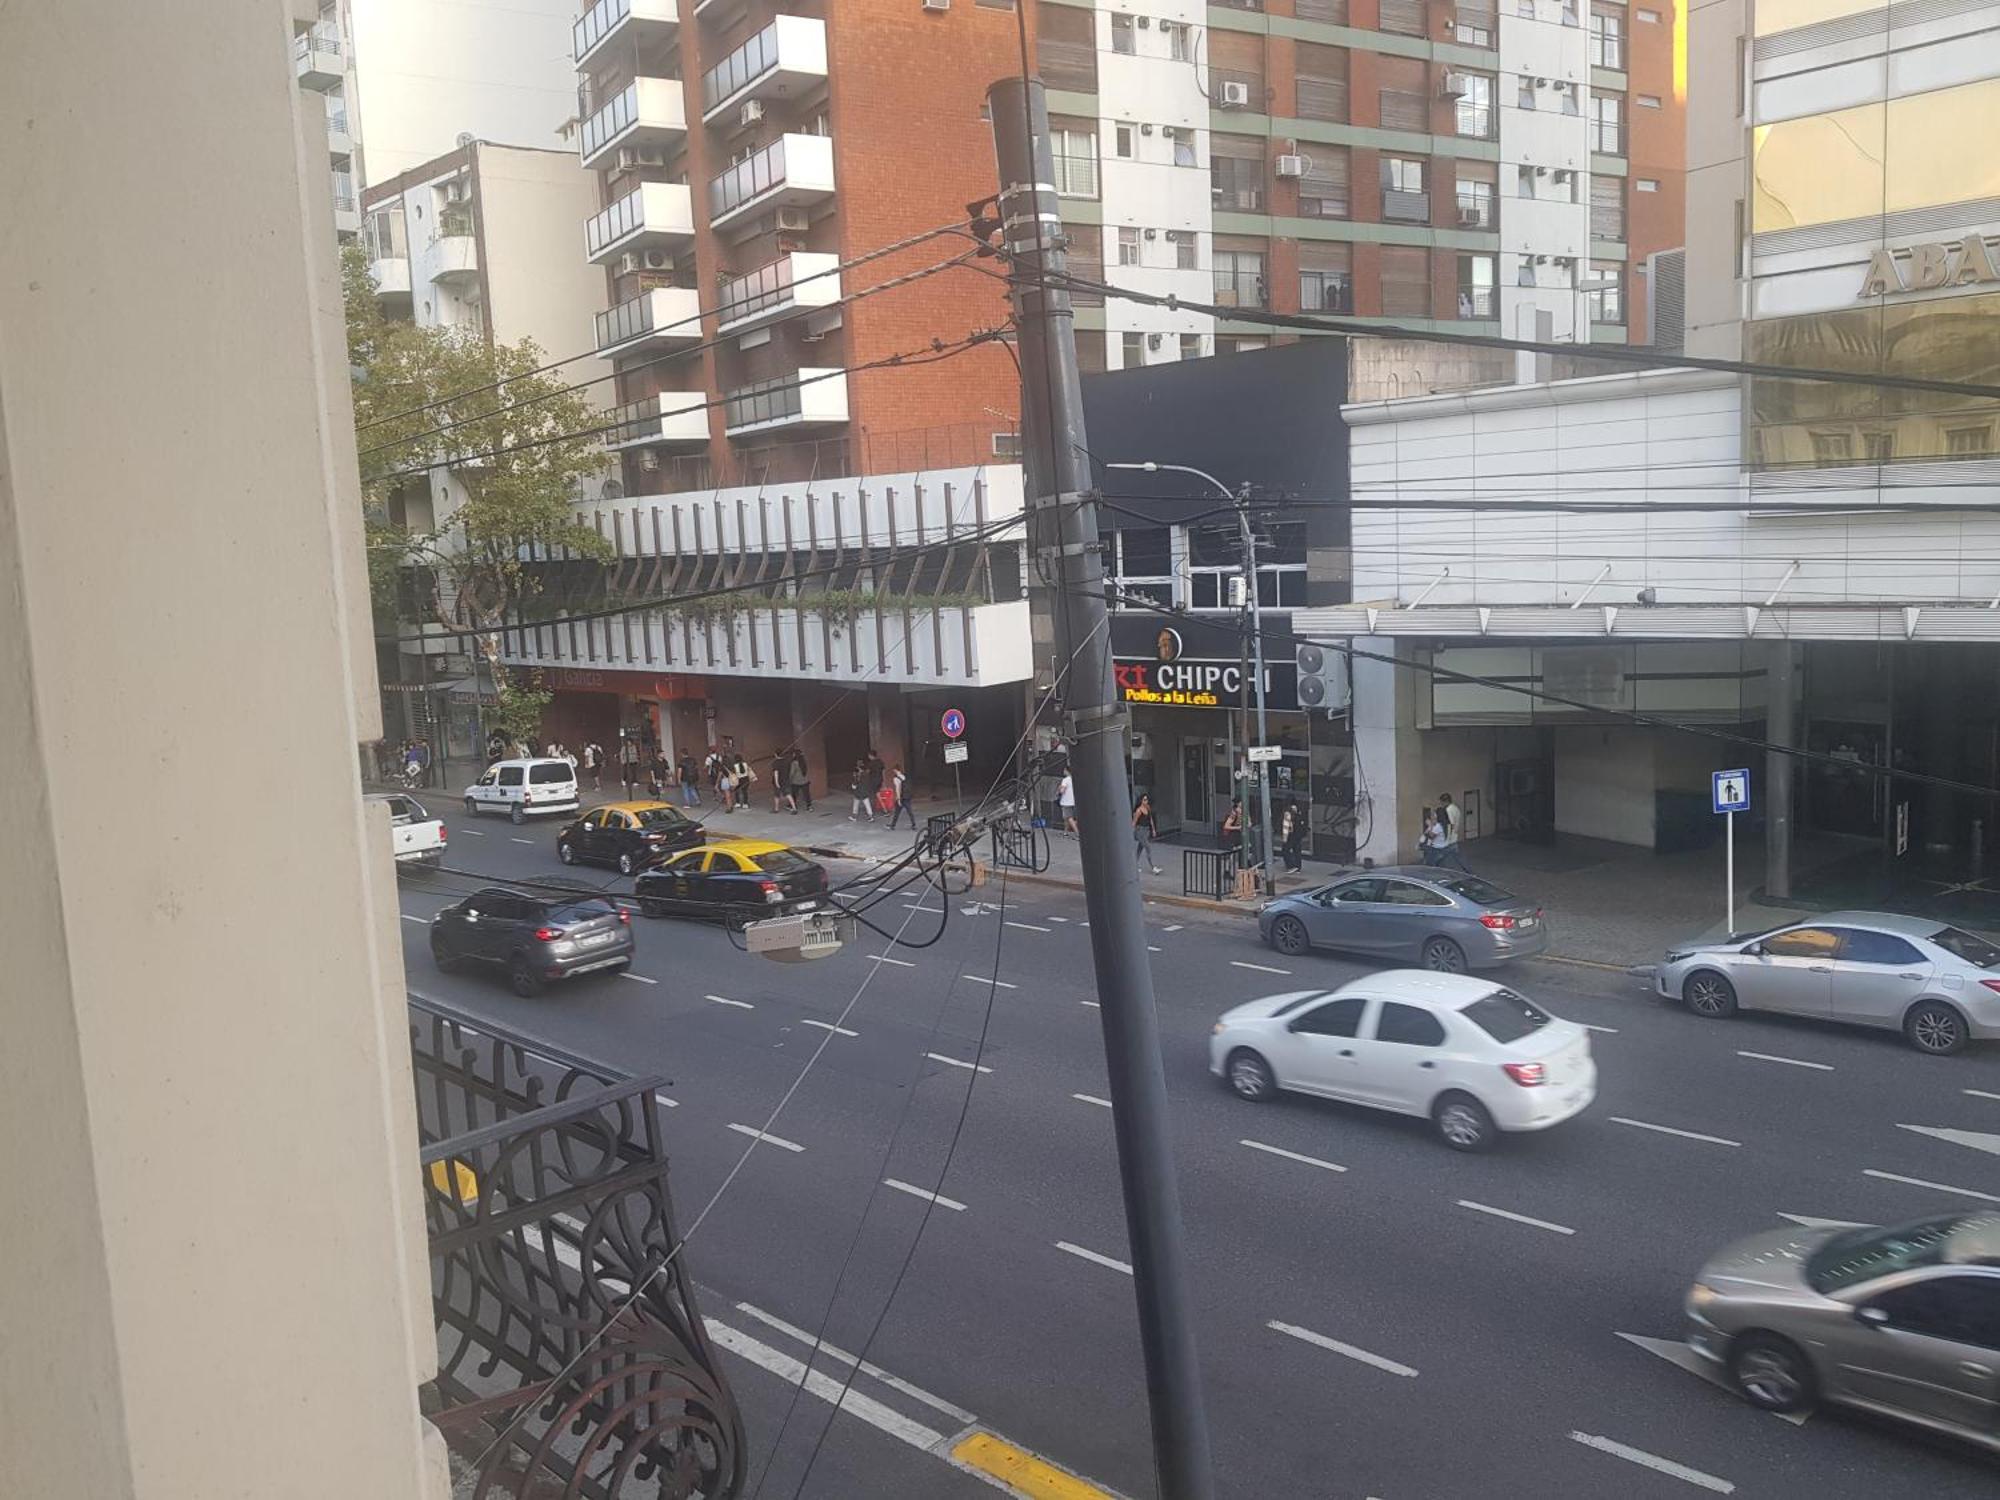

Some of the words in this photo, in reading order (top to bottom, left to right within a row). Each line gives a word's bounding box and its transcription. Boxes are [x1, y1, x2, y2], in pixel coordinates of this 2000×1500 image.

[1857, 233, 2000, 298] ABA
[1126, 688, 1161, 702] Pollos
[1163, 692, 1171, 703] a
[1173, 690, 1184, 704] la
[1187, 691, 1217, 705] Leña
